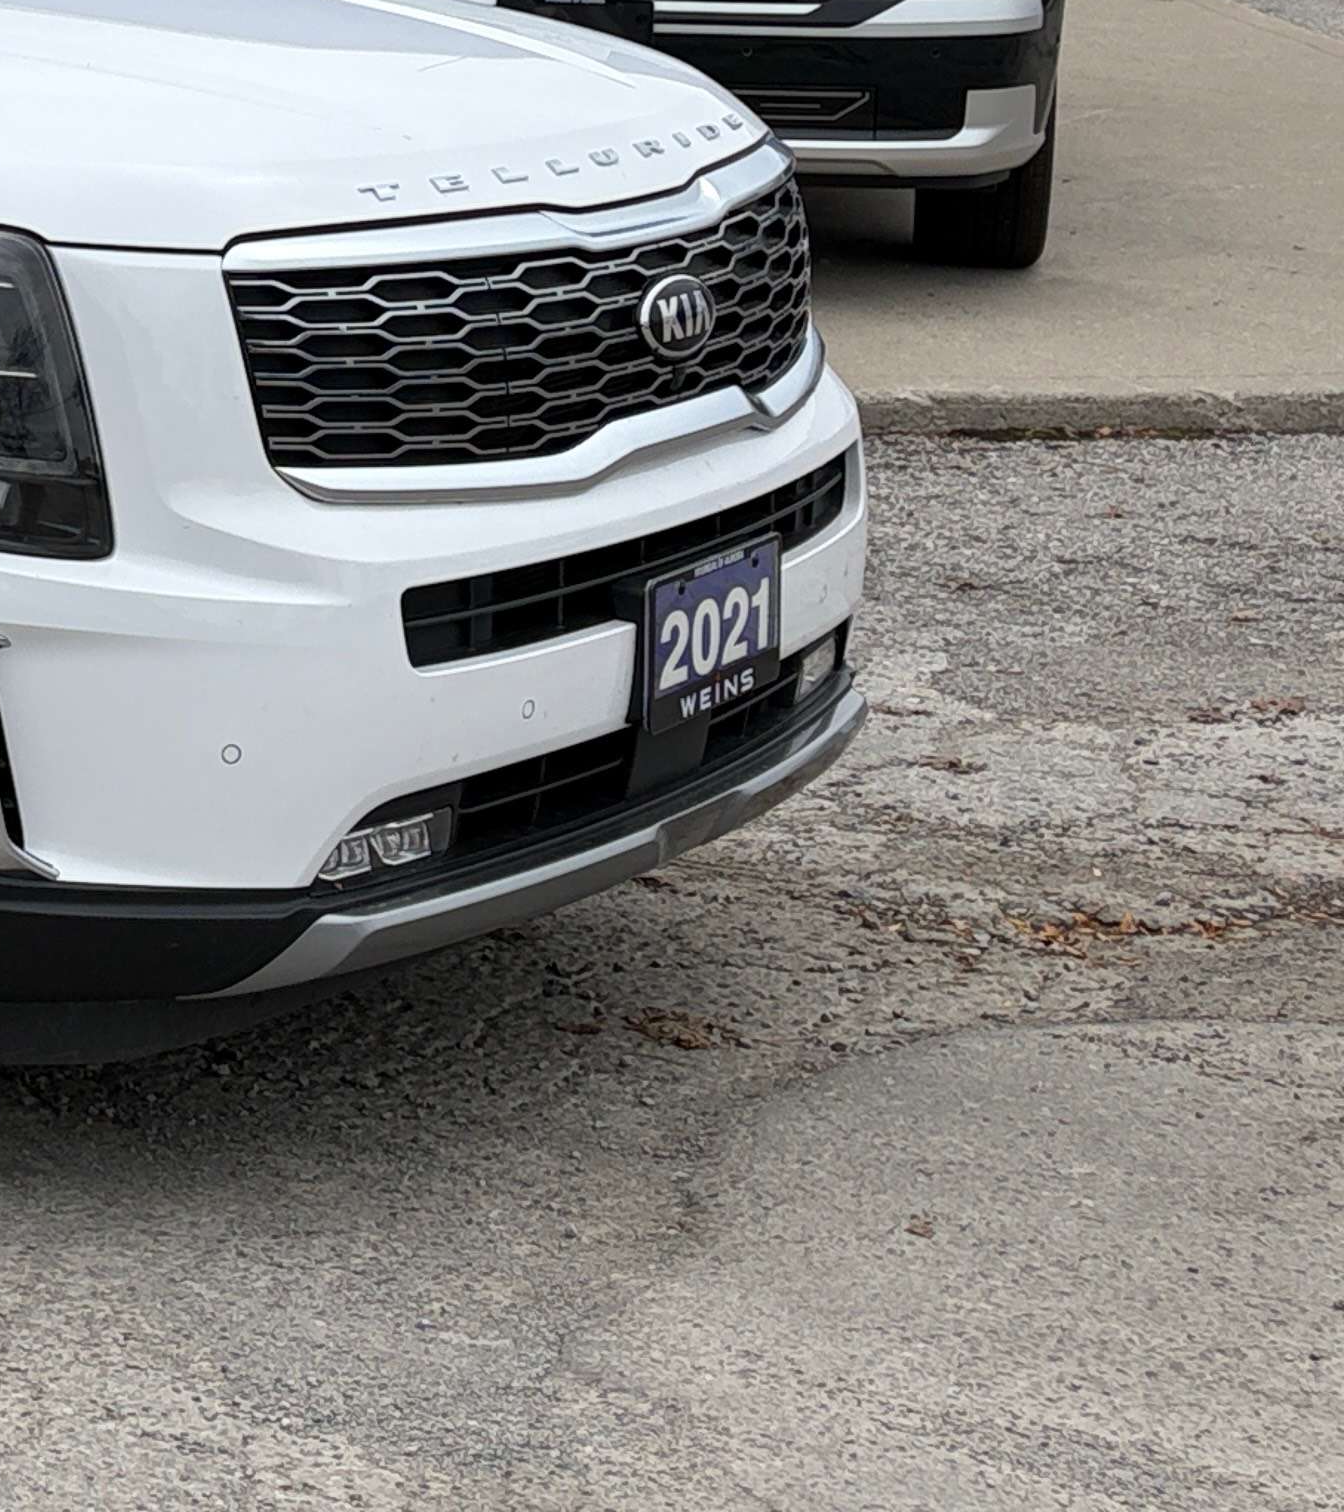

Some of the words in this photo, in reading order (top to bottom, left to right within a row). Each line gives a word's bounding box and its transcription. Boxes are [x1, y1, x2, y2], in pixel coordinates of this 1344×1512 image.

[358, 113, 746, 203] TELLURIDE
[656, 290, 711, 343] KIA
[658, 577, 770, 690] 2021
